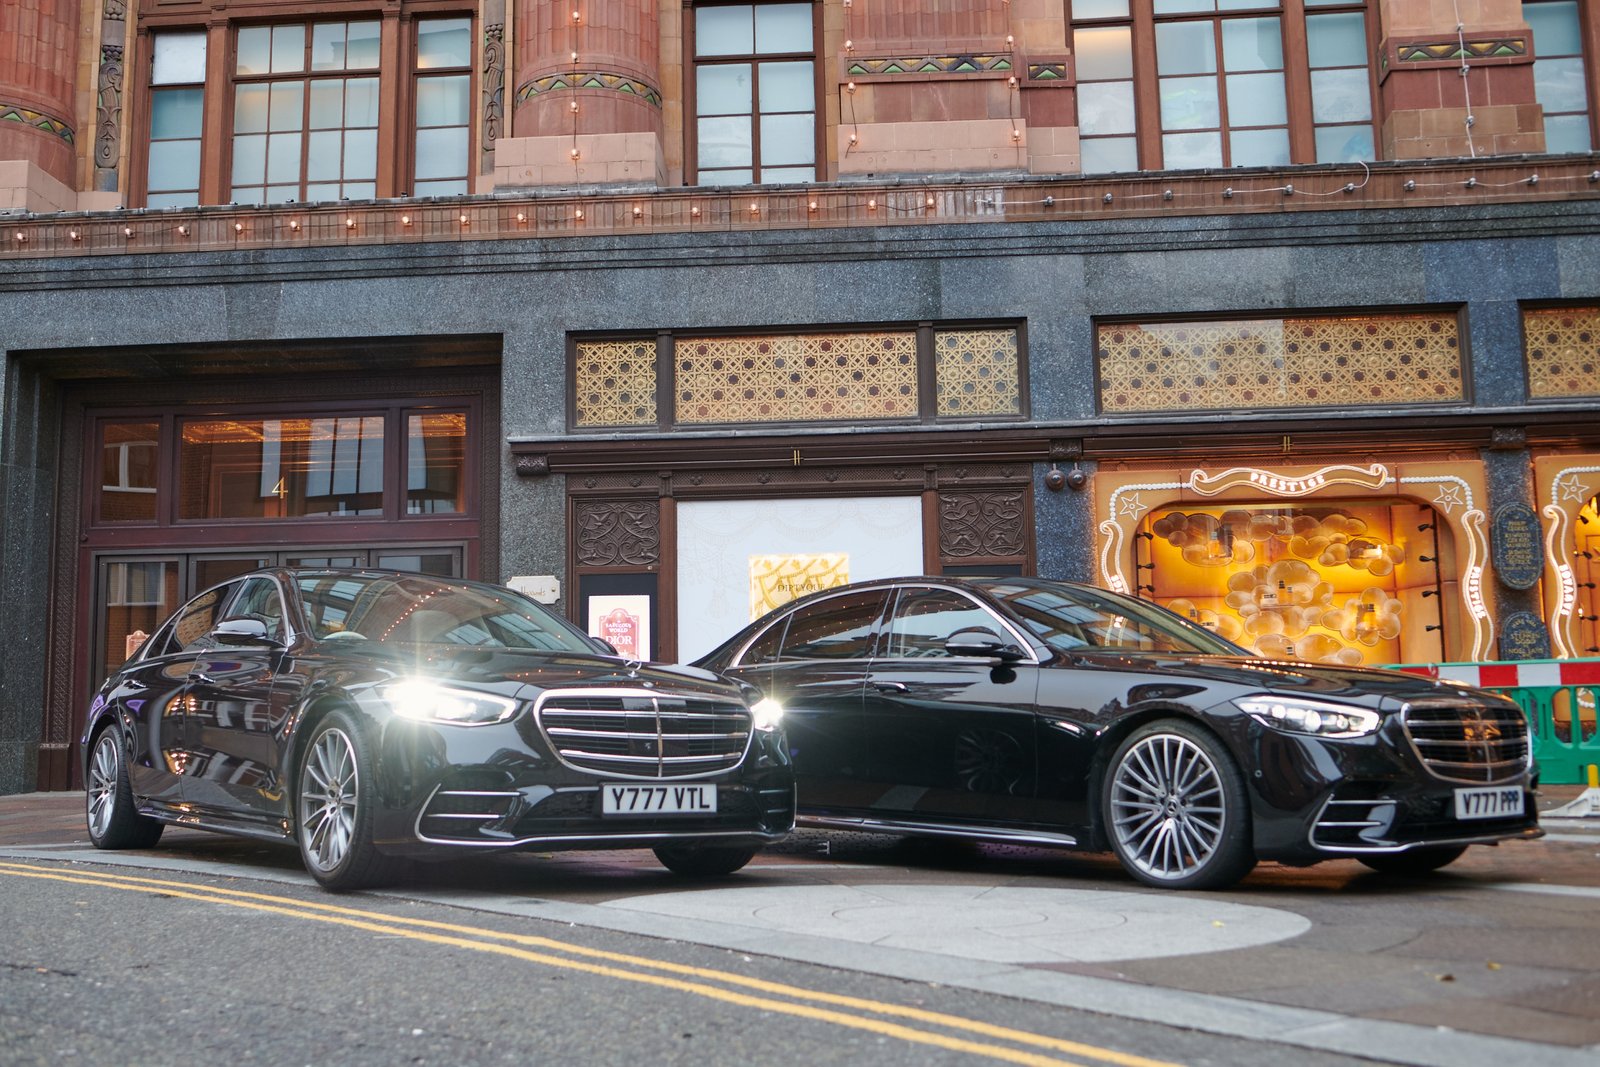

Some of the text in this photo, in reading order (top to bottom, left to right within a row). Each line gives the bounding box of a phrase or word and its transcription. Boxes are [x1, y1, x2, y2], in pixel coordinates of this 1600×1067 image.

[271, 476, 288, 499] 4
[1250, 472, 1325, 492] PRESTIGE
[777, 584, 825, 592] DIPTYQUE
[1468, 566, 1487, 619] PRESTIGE
[605, 636, 632, 645] DIOR
[612, 787, 710, 810] Y777 VTL
[1463, 789, 1519, 814] V777 PPP
